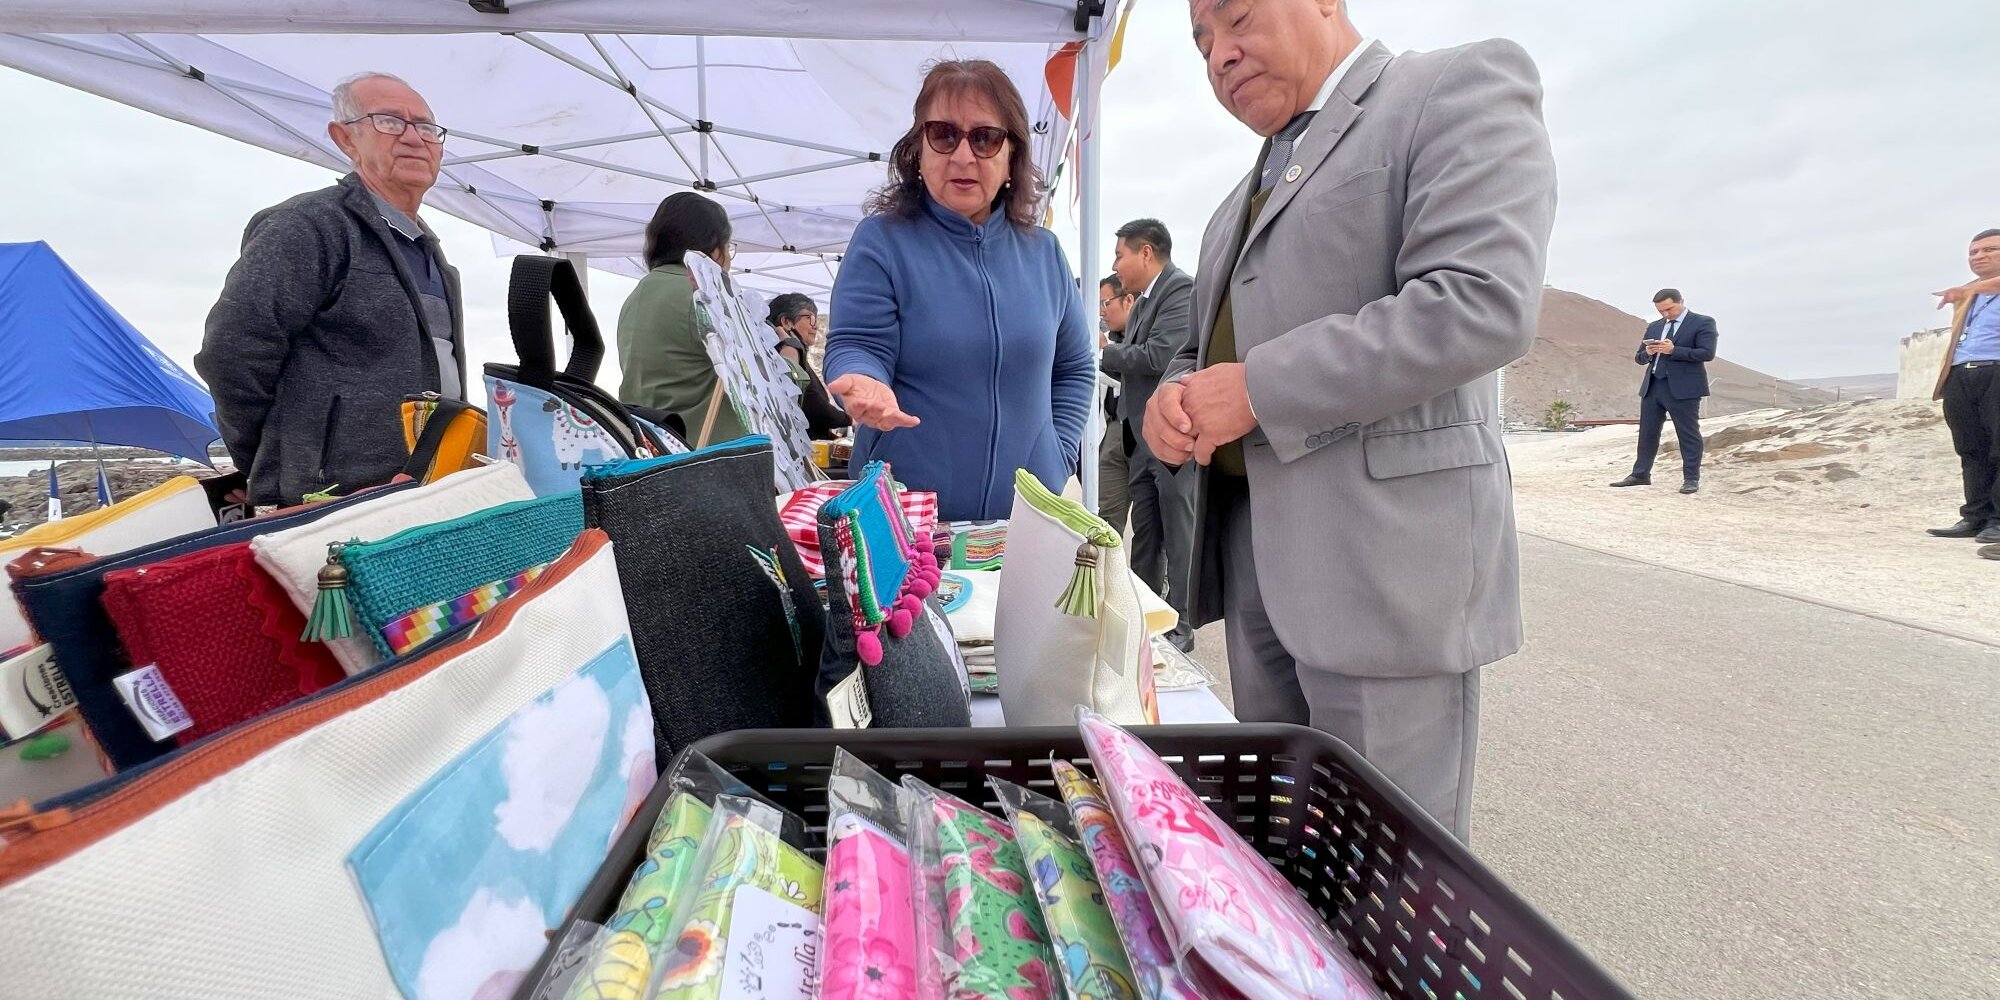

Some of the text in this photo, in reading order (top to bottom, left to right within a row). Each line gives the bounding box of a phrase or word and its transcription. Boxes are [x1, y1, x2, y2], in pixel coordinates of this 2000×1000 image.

[38, 664, 62, 709] Creaciones
[46, 654, 74, 706] ESTRELLA
[142, 672, 181, 723] ESTRELLA
[794, 942, 816, 1000] trella
